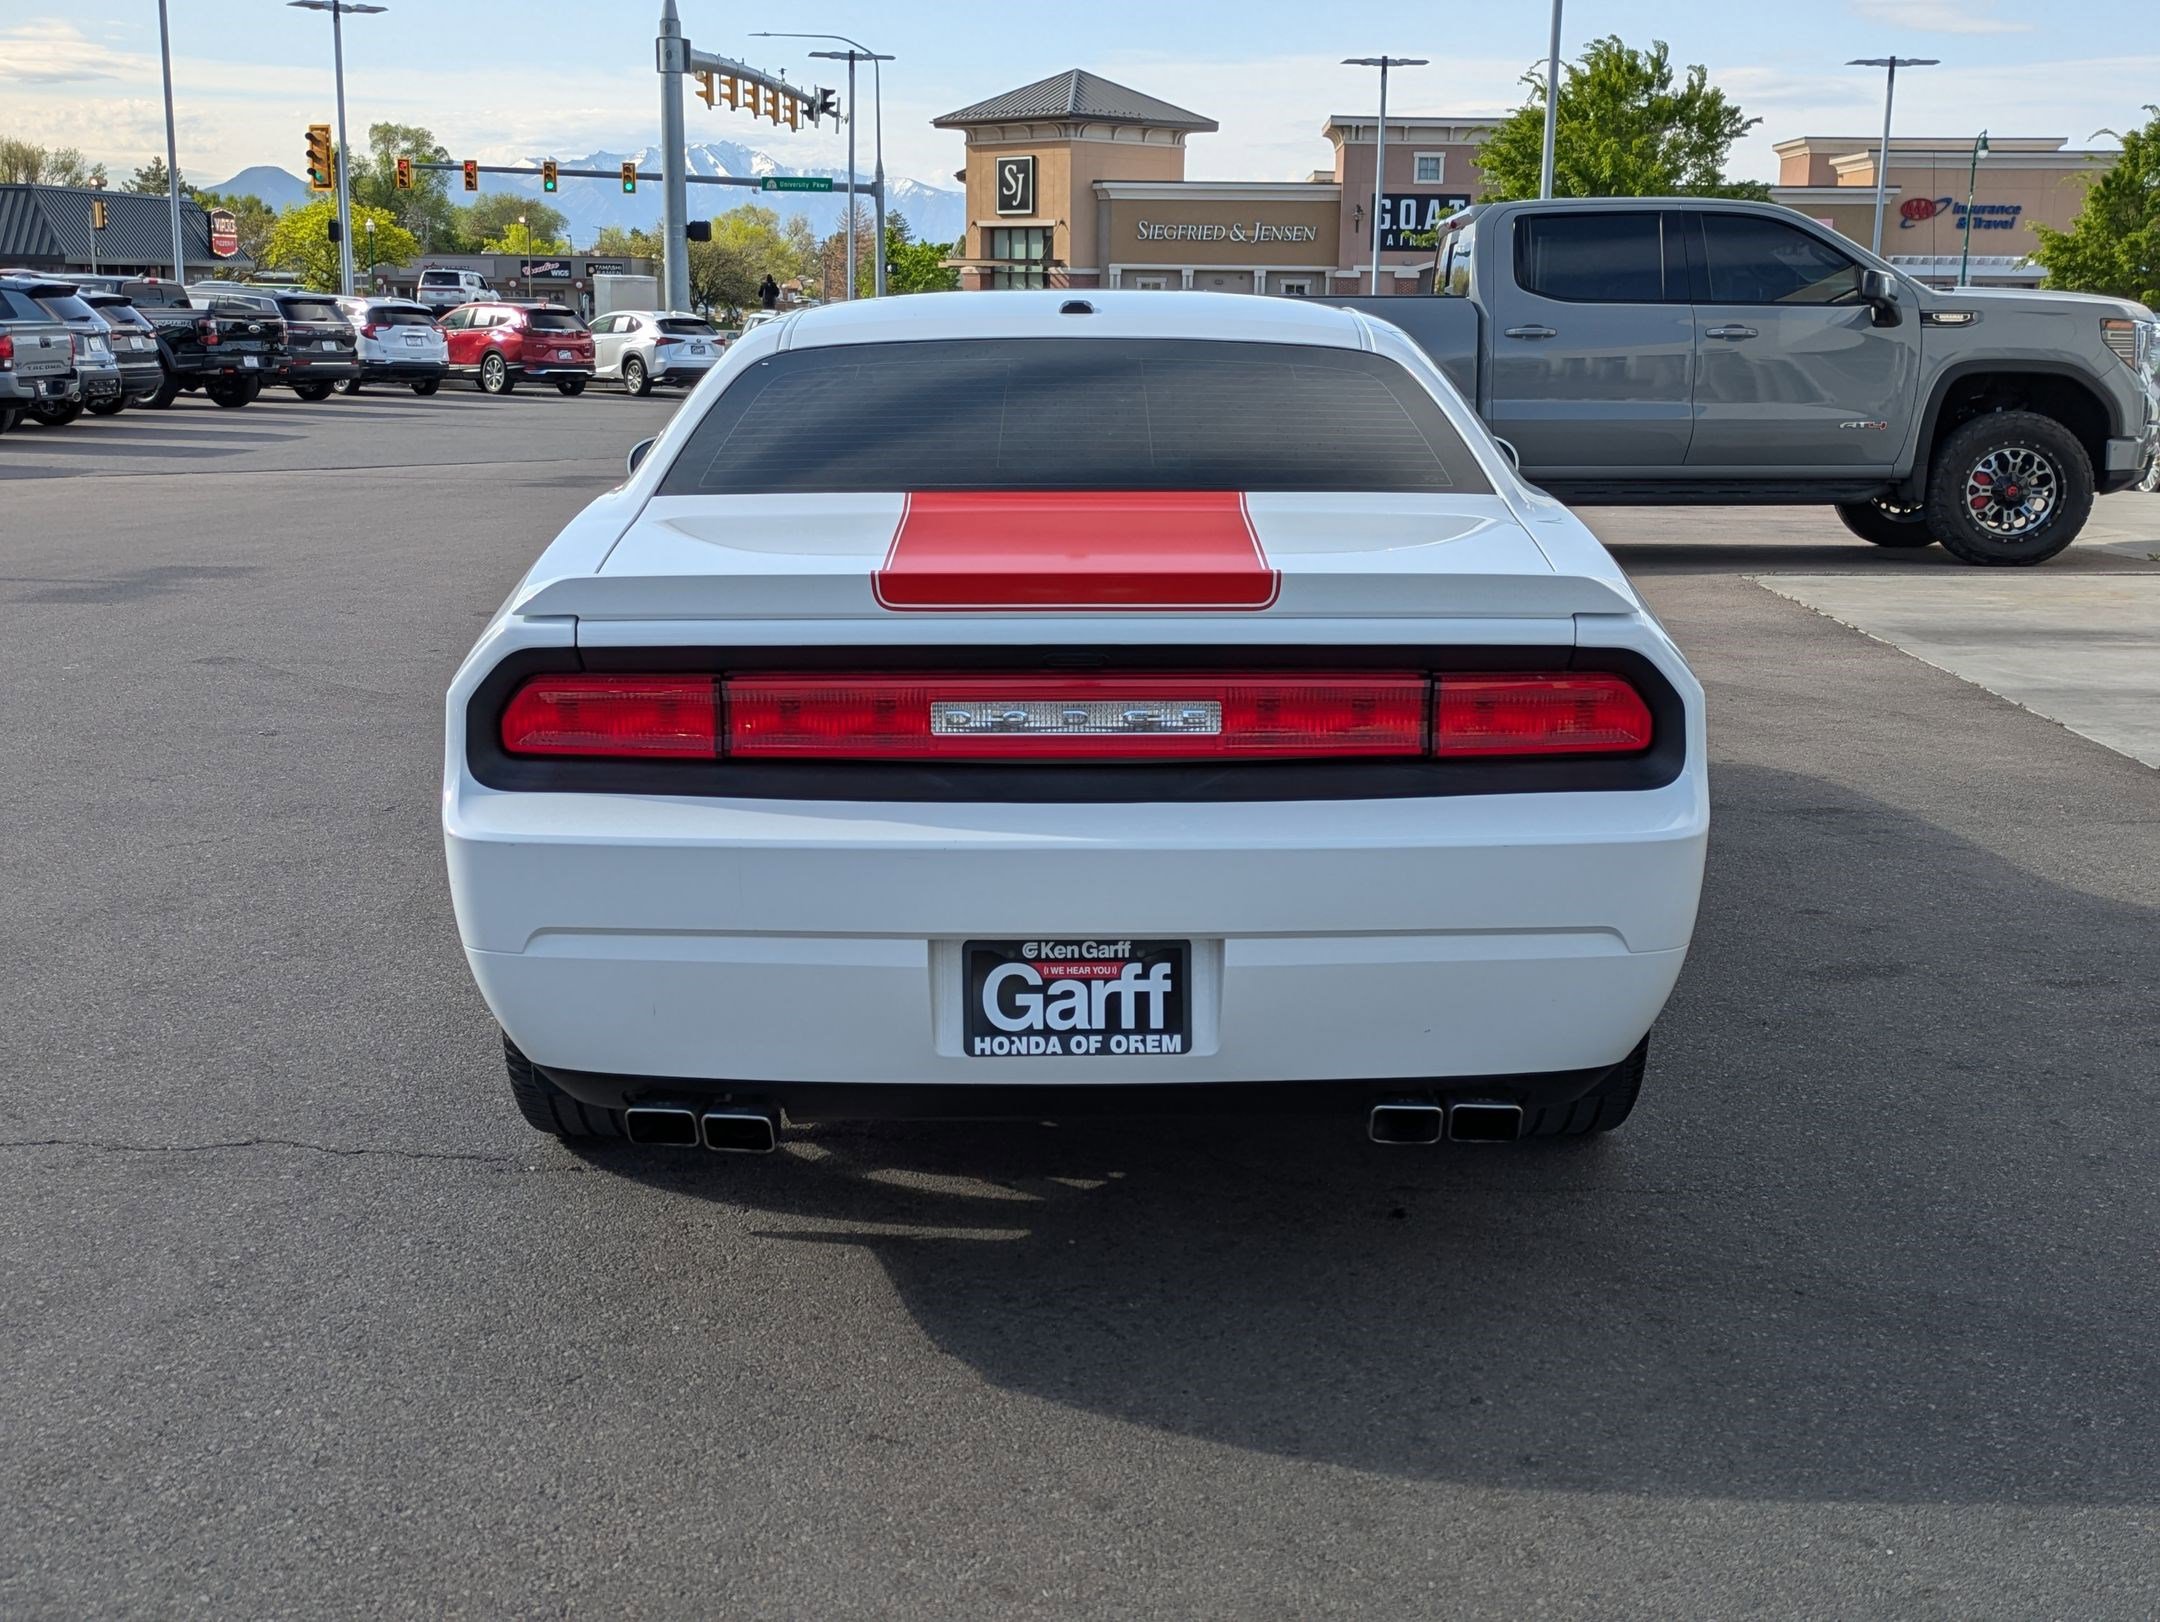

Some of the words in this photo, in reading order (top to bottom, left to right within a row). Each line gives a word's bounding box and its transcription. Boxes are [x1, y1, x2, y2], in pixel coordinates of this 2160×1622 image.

[780, 181, 810, 189] University
[1002, 164, 1025, 206] SJ
[1972, 216, 2016, 229] Travel
[1137, 220, 1226, 241] SIEGFRIED
[1229, 223, 1248, 242] &
[1251, 222, 1317, 244] JENSEN
[550, 269, 570, 277] WIGS
[944, 710, 1207, 726] DODGE
[1040, 941, 1080, 959] Ken
[1081, 941, 1131, 959] Garff
[1050, 966, 1065, 975] WE
[1066, 966, 1090, 975] HEAR
[1092, 966, 1111, 975] YOU
[982, 962, 1172, 1032] Garff
[974, 1035, 1063, 1055] HONDA
[1070, 1035, 1102, 1054] OF
[1110, 1034, 1182, 1054] OREM
